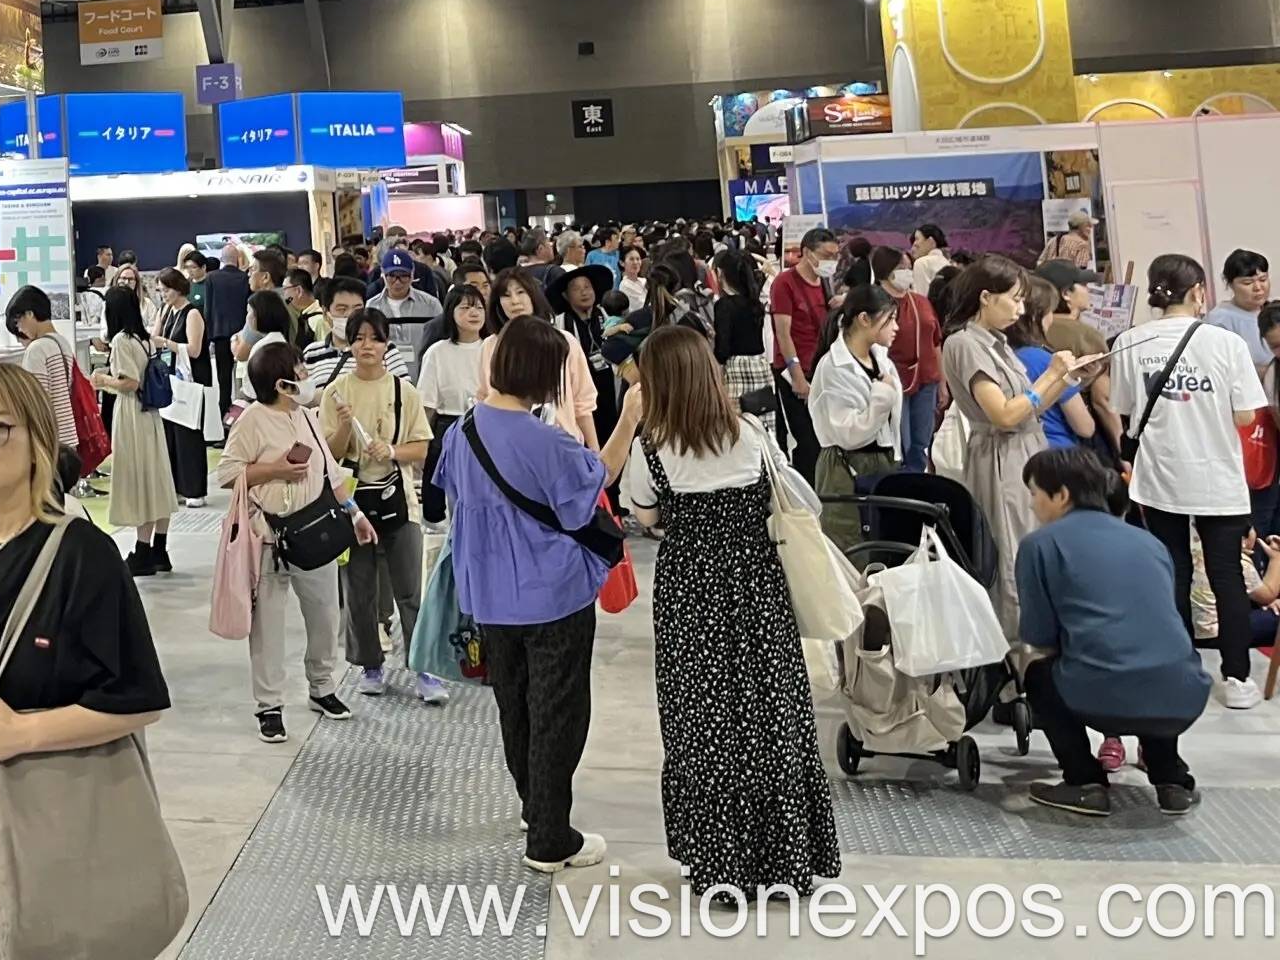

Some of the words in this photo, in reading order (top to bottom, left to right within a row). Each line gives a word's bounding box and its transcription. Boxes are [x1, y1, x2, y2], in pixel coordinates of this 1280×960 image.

[84, 7, 157, 24] フードコート
[98, 26, 118, 35] Food
[121, 25, 143, 34] Court
[202, 76, 229, 91] F-3
[582, 105, 604, 124] 東
[101, 126, 152, 141] イタリア
[240, 128, 272, 144] イタリア
[329, 123, 375, 137] ITALIA
[15, 132, 44, 147] ITAA
[208, 174, 282, 187] FINNAIR
